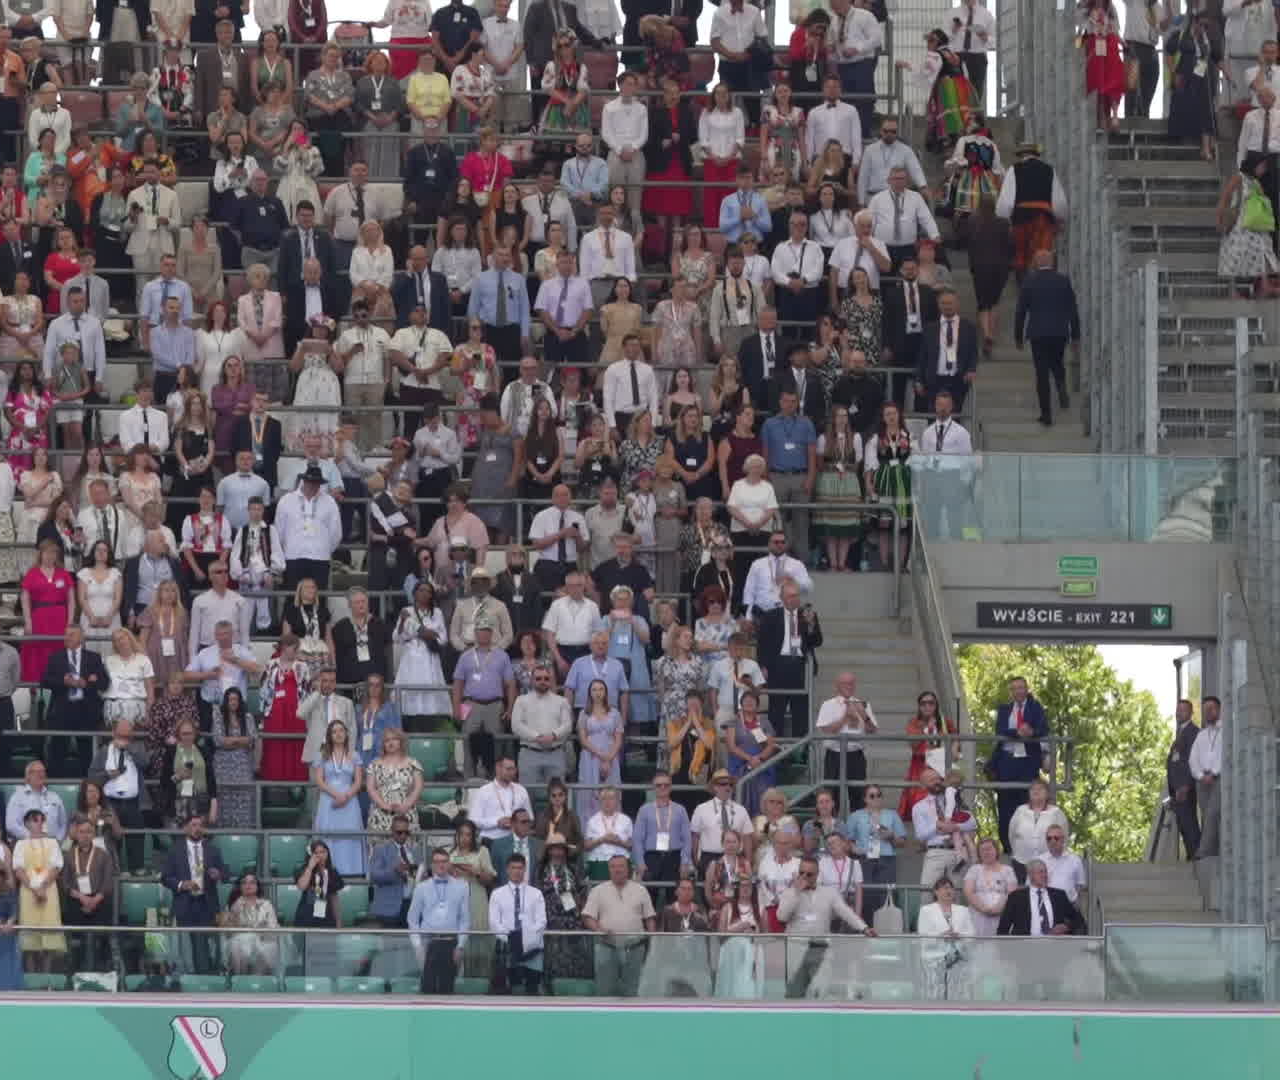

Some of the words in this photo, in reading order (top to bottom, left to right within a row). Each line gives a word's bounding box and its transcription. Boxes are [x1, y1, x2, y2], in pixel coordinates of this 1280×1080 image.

[993, 608, 1063, 623] WYJŚCIE
[1076, 612, 1101, 623] EXIT
[1110, 611, 1135, 623] 221
